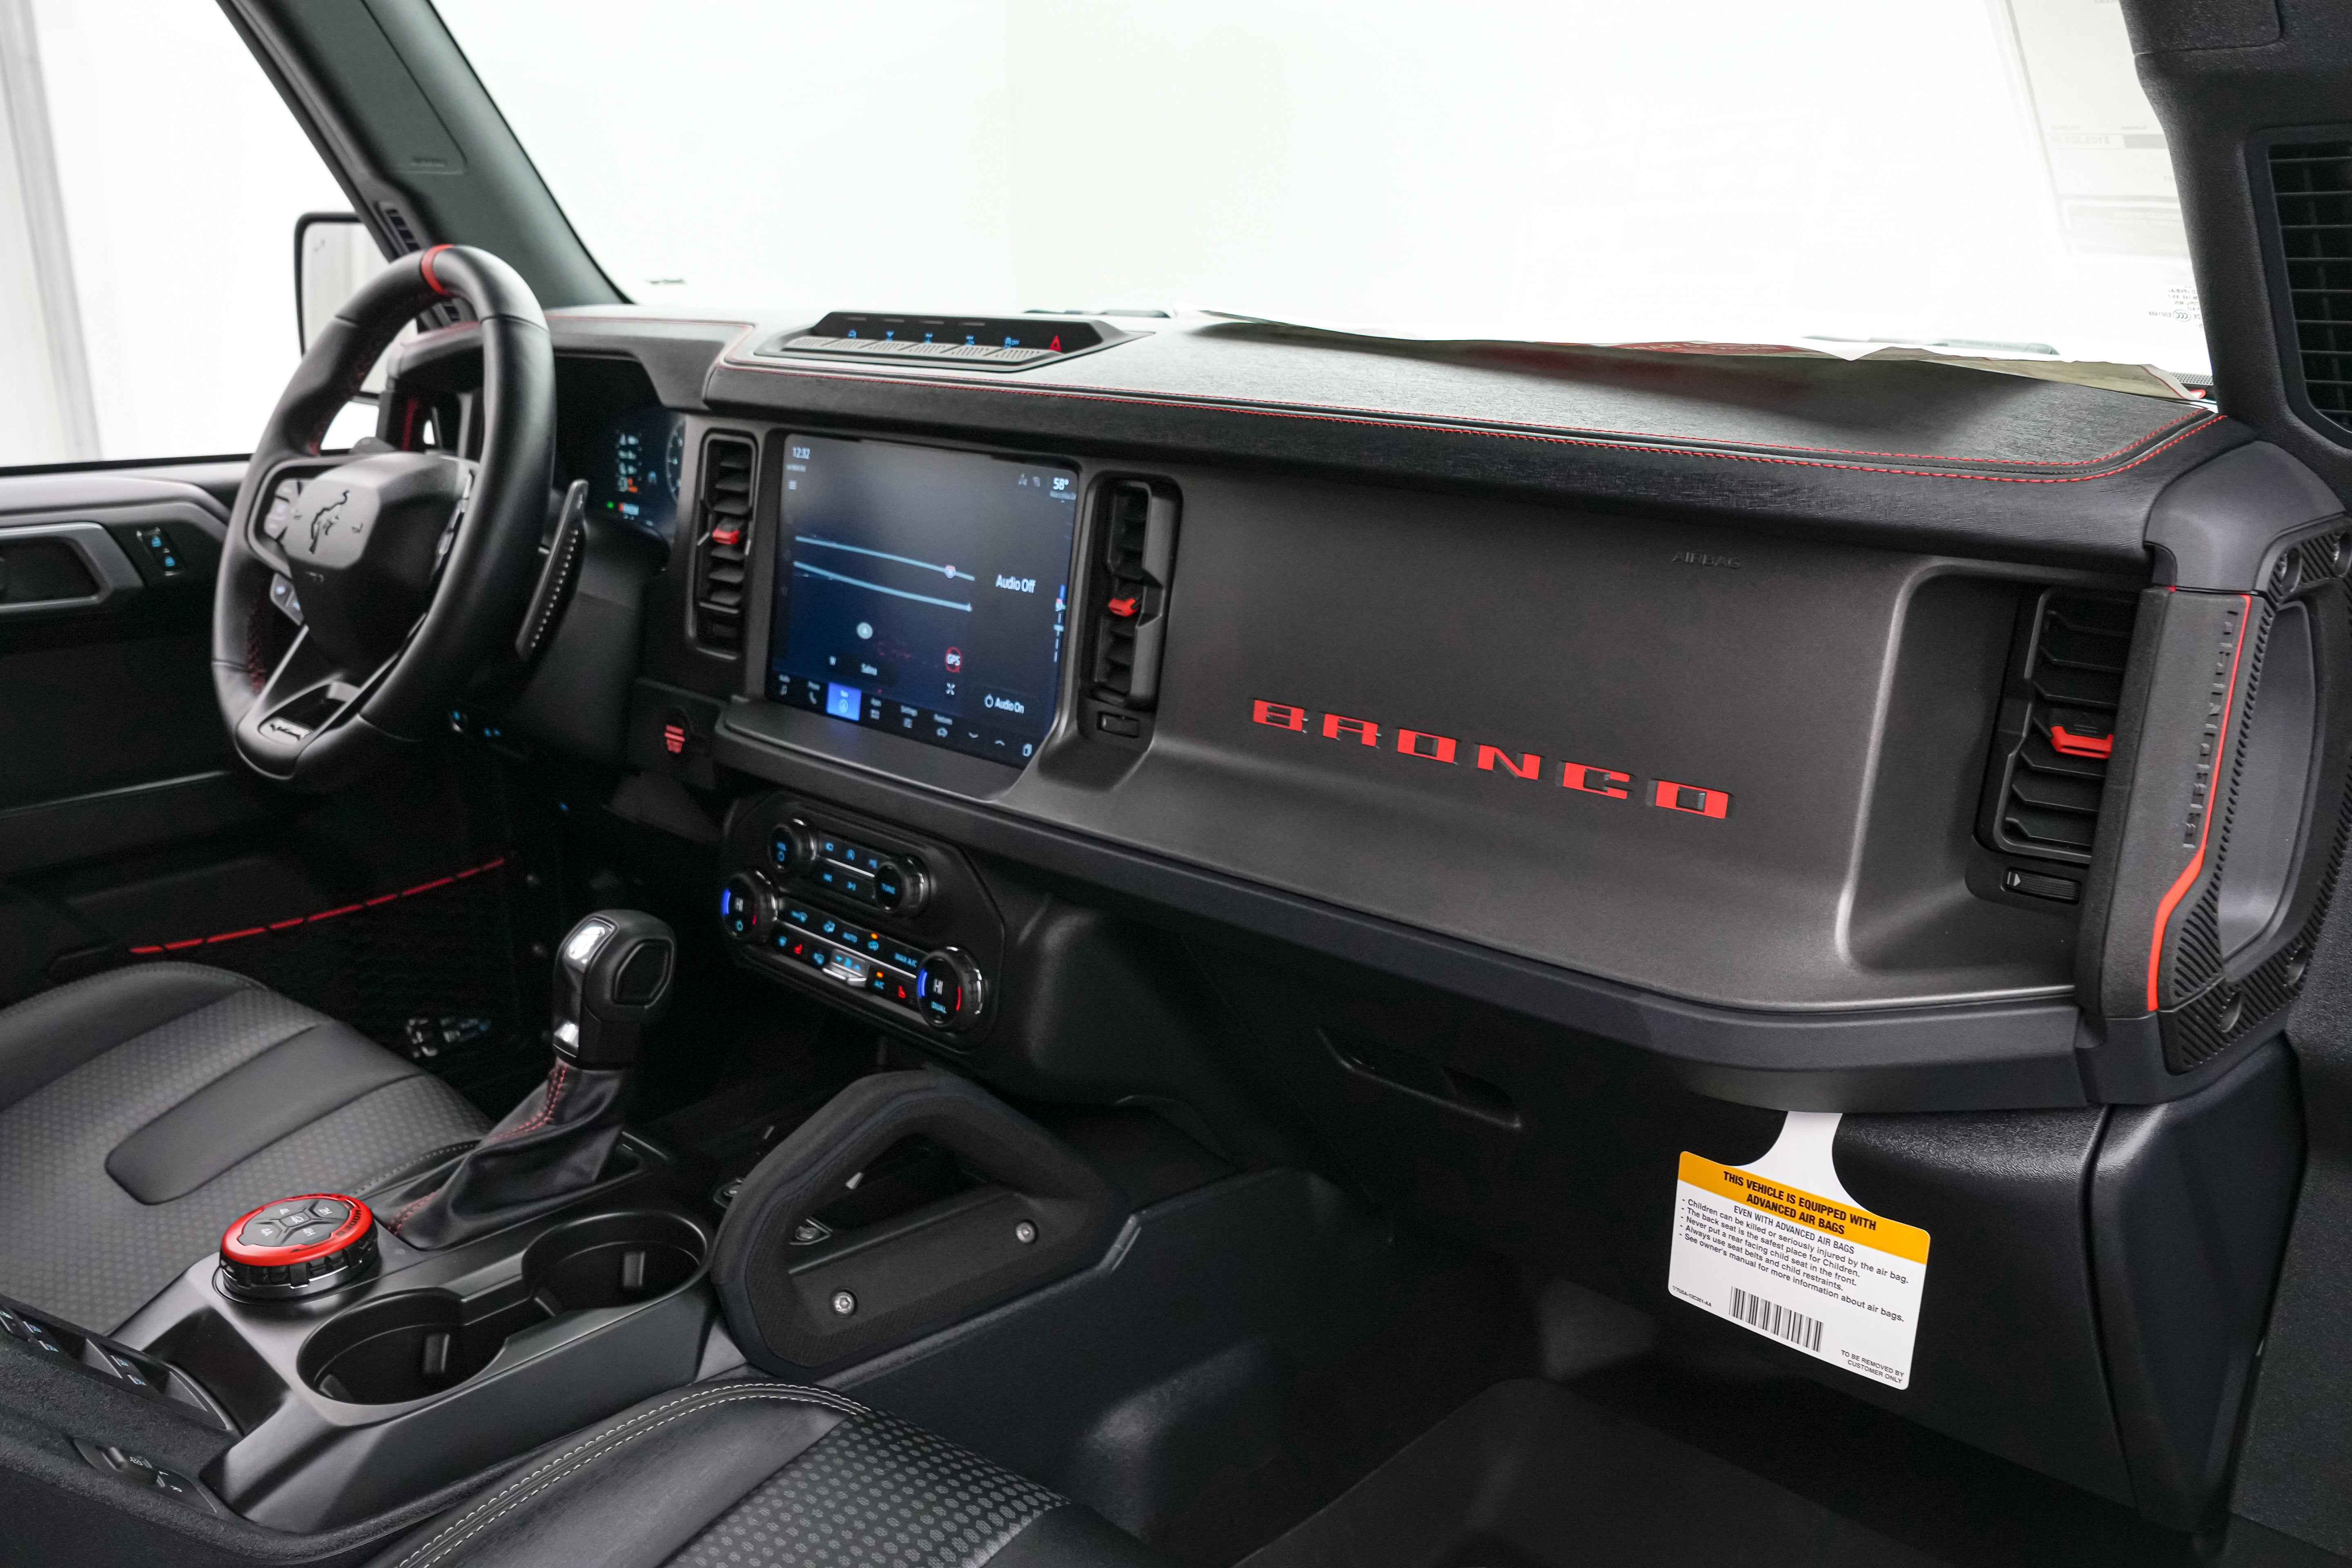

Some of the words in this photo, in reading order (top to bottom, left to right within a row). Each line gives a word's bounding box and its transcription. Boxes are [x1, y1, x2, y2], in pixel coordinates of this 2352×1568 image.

[995, 574, 1020, 591] Audio
[1021, 578, 1036, 593] Off
[1672, 551, 1741, 569] AIRBAG
[946, 653, 961, 666] GPS
[994, 697, 1014, 712] Audio
[1014, 702, 1025, 714] On
[2182, 610, 2238, 849] BRONCO
[1253, 699, 1729, 819] BRONCO
[930, 1001, 947, 1014] DUAL
[1723, 1171, 1744, 1186] THIS
[1746, 1179, 1784, 1200] VEHICLE
[1786, 1192, 1796, 1204] IS
[1798, 1197, 1846, 1221] EQUIPPED
[1849, 1213, 1876, 1230] WITH
[1746, 1194, 1796, 1218] ADVANCED
[1798, 1211, 1815, 1225] AIR
[1818, 1218, 1844, 1234] BAGS
[1686, 1216, 1707, 1229] Never
[1708, 1226, 1720, 1235] put
[1728, 1234, 1743, 1243] rear
[1744, 1239, 1768, 1255] facing
[1770, 1250, 1789, 1261] child
[1791, 1258, 1808, 1269] seat
[1809, 1263, 1817, 1272] in
[1819, 1267, 1832, 1277] the
[1834, 1272, 1857, 1286] front.
[1687, 1207, 1700, 1218] The
[1702, 1213, 1719, 1225] back
[1720, 1222, 1736, 1232] seat
[1738, 1227, 1745, 1235] is
[1746, 1231, 1759, 1241] the
[1760, 1237, 1784, 1250] safest
[1785, 1246, 1807, 1258] place
[1809, 1253, 1821, 1263] for
[1822, 1258, 1860, 1277] Children.
[1688, 1199, 1717, 1216] Children
[1719, 1212, 1733, 1222] can
[1734, 1216, 1744, 1226] be
[1746, 1221, 1766, 1234] killed
[1778, 1234, 1815, 1253] seriously
[1817, 1246, 1846, 1262] injured
[1847, 1257, 1858, 1268] by
[1860, 1261, 1874, 1272] the
[1875, 1268, 1888, 1276] air
[1889, 1271, 1908, 1284] bag.
[1733, 1205, 1752, 1218] EVEN
[1754, 1212, 1773, 1226] WITH
[1775, 1221, 1815, 1241] ADVANCED
[1817, 1235, 1831, 1247] AIR
[1833, 1240, 1854, 1254] BAGS
[1684, 1233, 1698, 1244] See
[1699, 1241, 1727, 1256] owner's
[1728, 1252, 1756, 1267] manual
[1757, 1263, 1769, 1272] for
[1771, 1269, 1791, 1281] more
[1792, 1276, 1838, 1299] information
[1840, 1295, 1865, 1308] about
[1867, 1304, 1879, 1313] air
[1880, 1307, 1904, 1322] bags.
[1685, 1225, 1711, 1240] Always
[1712, 1236, 1726, 1246] use
[1727, 1243, 1743, 1254] seat
[1744, 1248, 1763, 1261] belts
[1764, 1257, 1780, 1267] and
[1781, 1264, 1801, 1275] child
[1802, 1272, 1843, 1291] restraints.
[1841, 1350, 1850, 1358] TO
[1851, 1353, 1860, 1362] BE
[1861, 1357, 1893, 1373] REMOVED
[1847, 1359, 1883, 1377] CUSTOMER
[1884, 1373, 1902, 1383] ONLY
